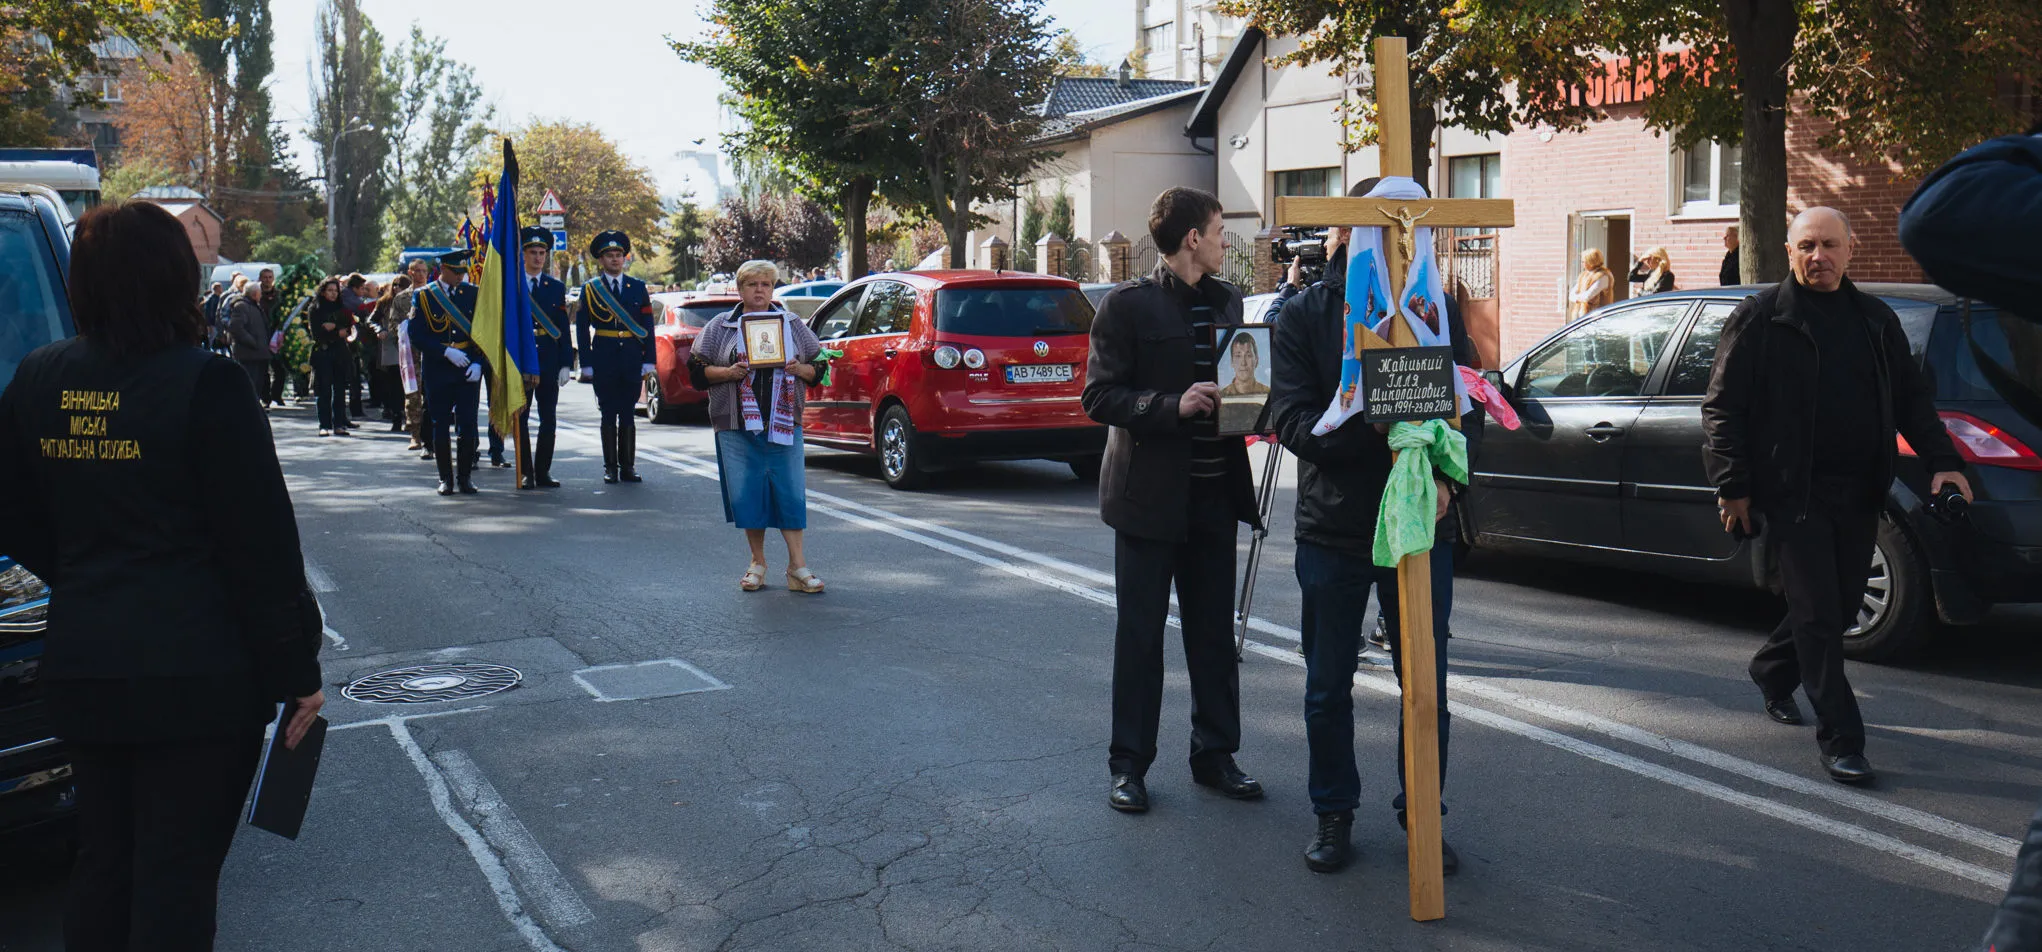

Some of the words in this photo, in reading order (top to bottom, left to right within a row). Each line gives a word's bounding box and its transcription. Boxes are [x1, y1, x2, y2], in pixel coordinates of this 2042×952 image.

[1014, 367, 1029, 378] AB
[1031, 366, 1053, 378] 7489
[1055, 365, 1070, 377] CE
[61, 390, 120, 414] ВІННИЦЬКА
[70, 416, 107, 436] МІСЬКА
[40, 438, 95, 459] РИТУАЛЬНА
[98, 440, 141, 460] СЛУЖБА
